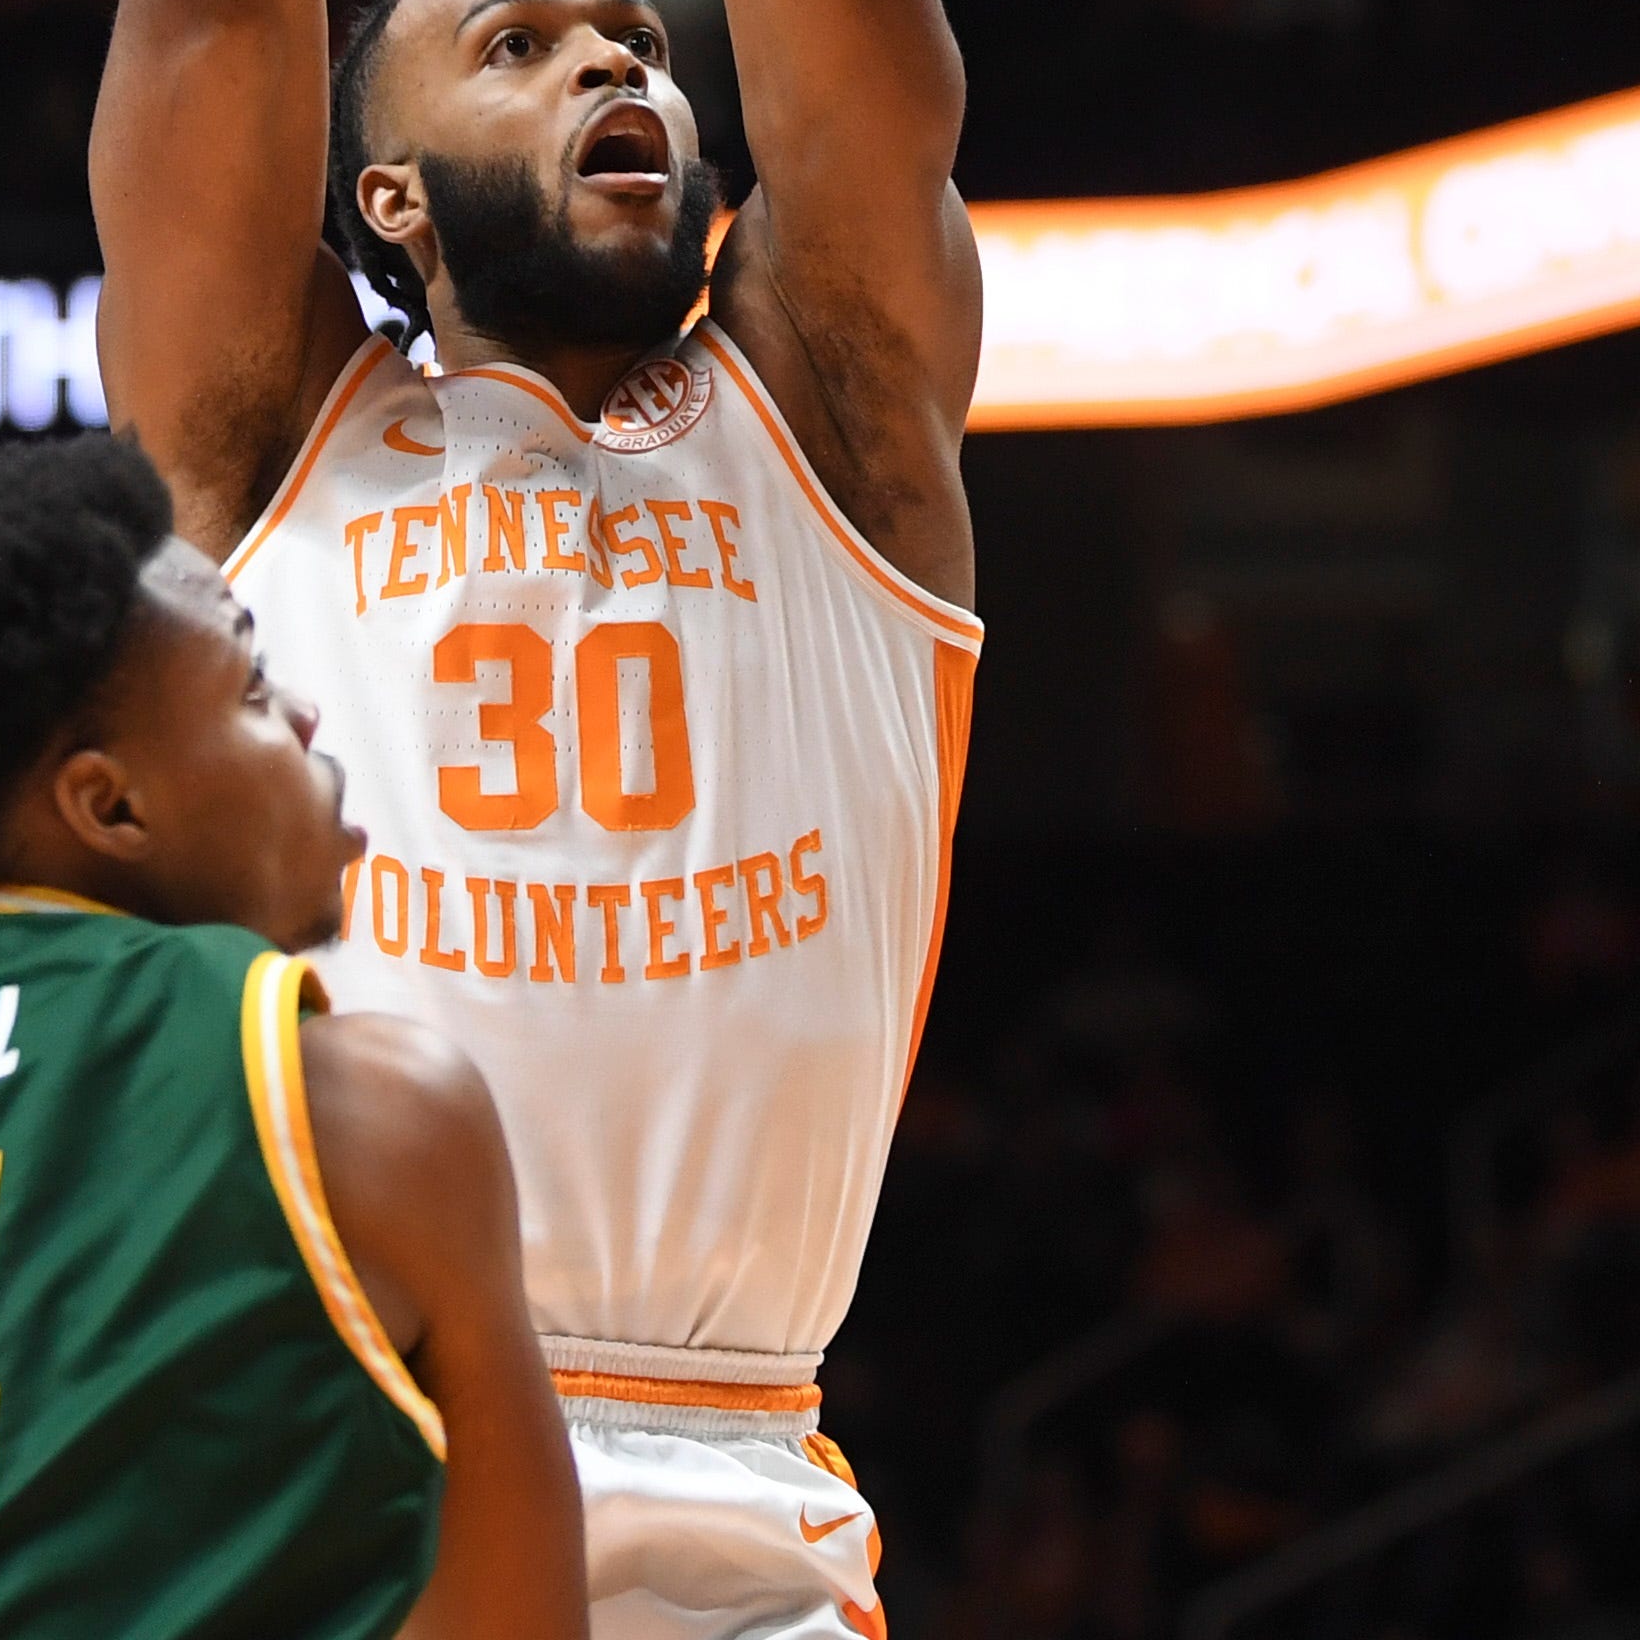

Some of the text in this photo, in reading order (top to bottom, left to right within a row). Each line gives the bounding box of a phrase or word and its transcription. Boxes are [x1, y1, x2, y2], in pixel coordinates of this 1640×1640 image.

[607, 361, 685, 430] SEC
[616, 392, 707, 450] GRADUATE
[344, 482, 758, 616] TENNESSEE
[433, 622, 696, 832] 30
